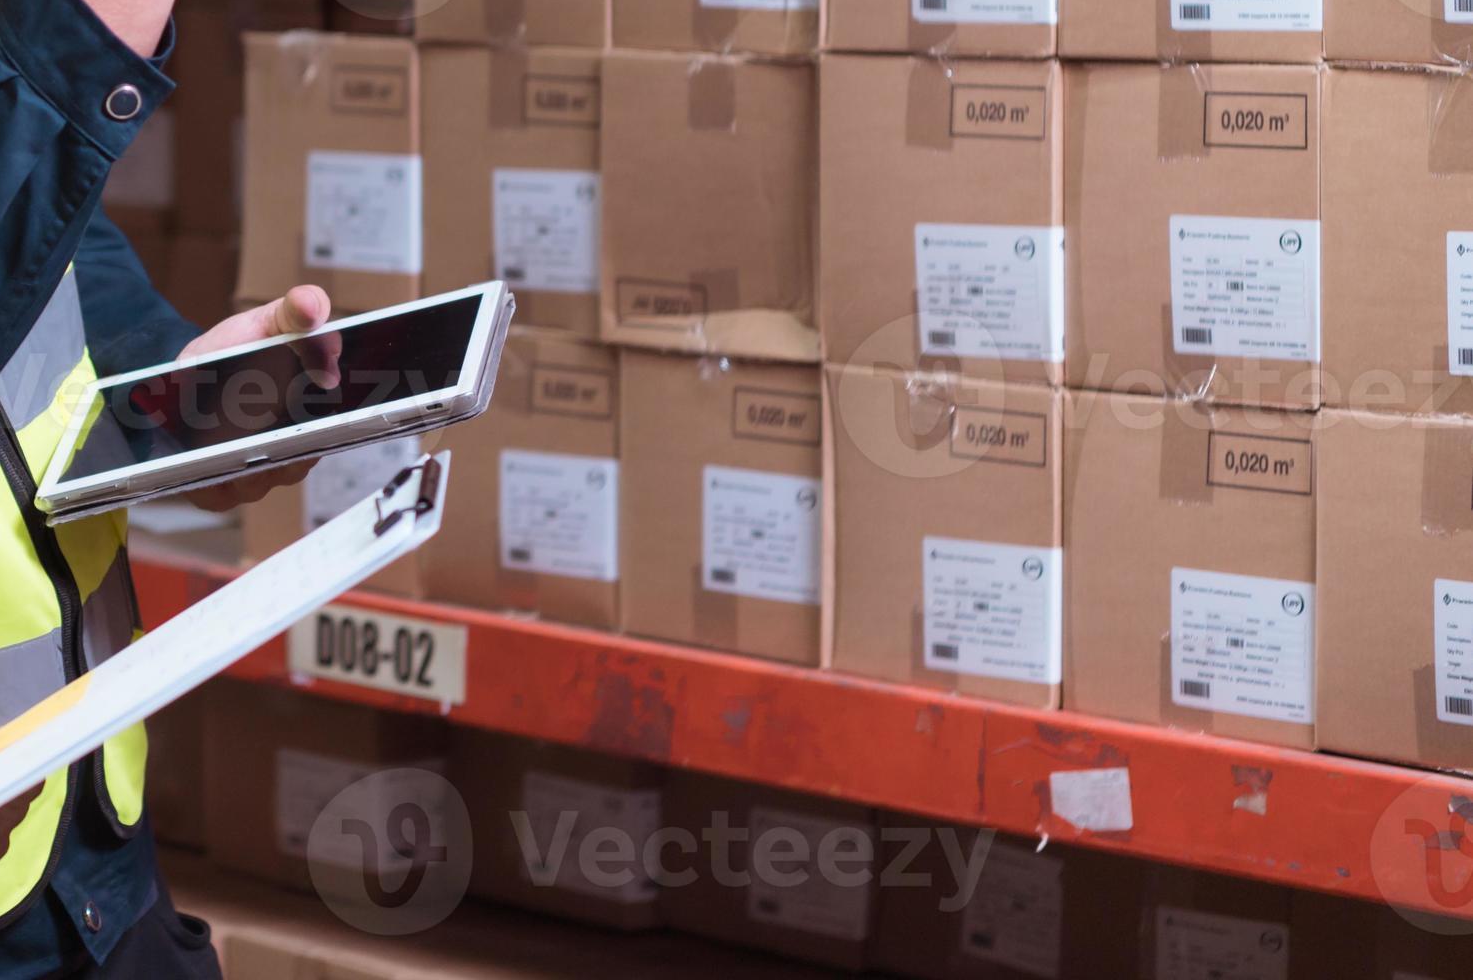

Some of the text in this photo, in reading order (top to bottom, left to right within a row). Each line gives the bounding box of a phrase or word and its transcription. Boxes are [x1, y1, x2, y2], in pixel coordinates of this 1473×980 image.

[967, 102, 1006, 124] 0,020
[1221, 111, 1289, 133] 0,020 m³
[966, 423, 1005, 447] 0,020
[1225, 450, 1294, 476] 0,020 m³
[317, 614, 434, 686] D08-02
